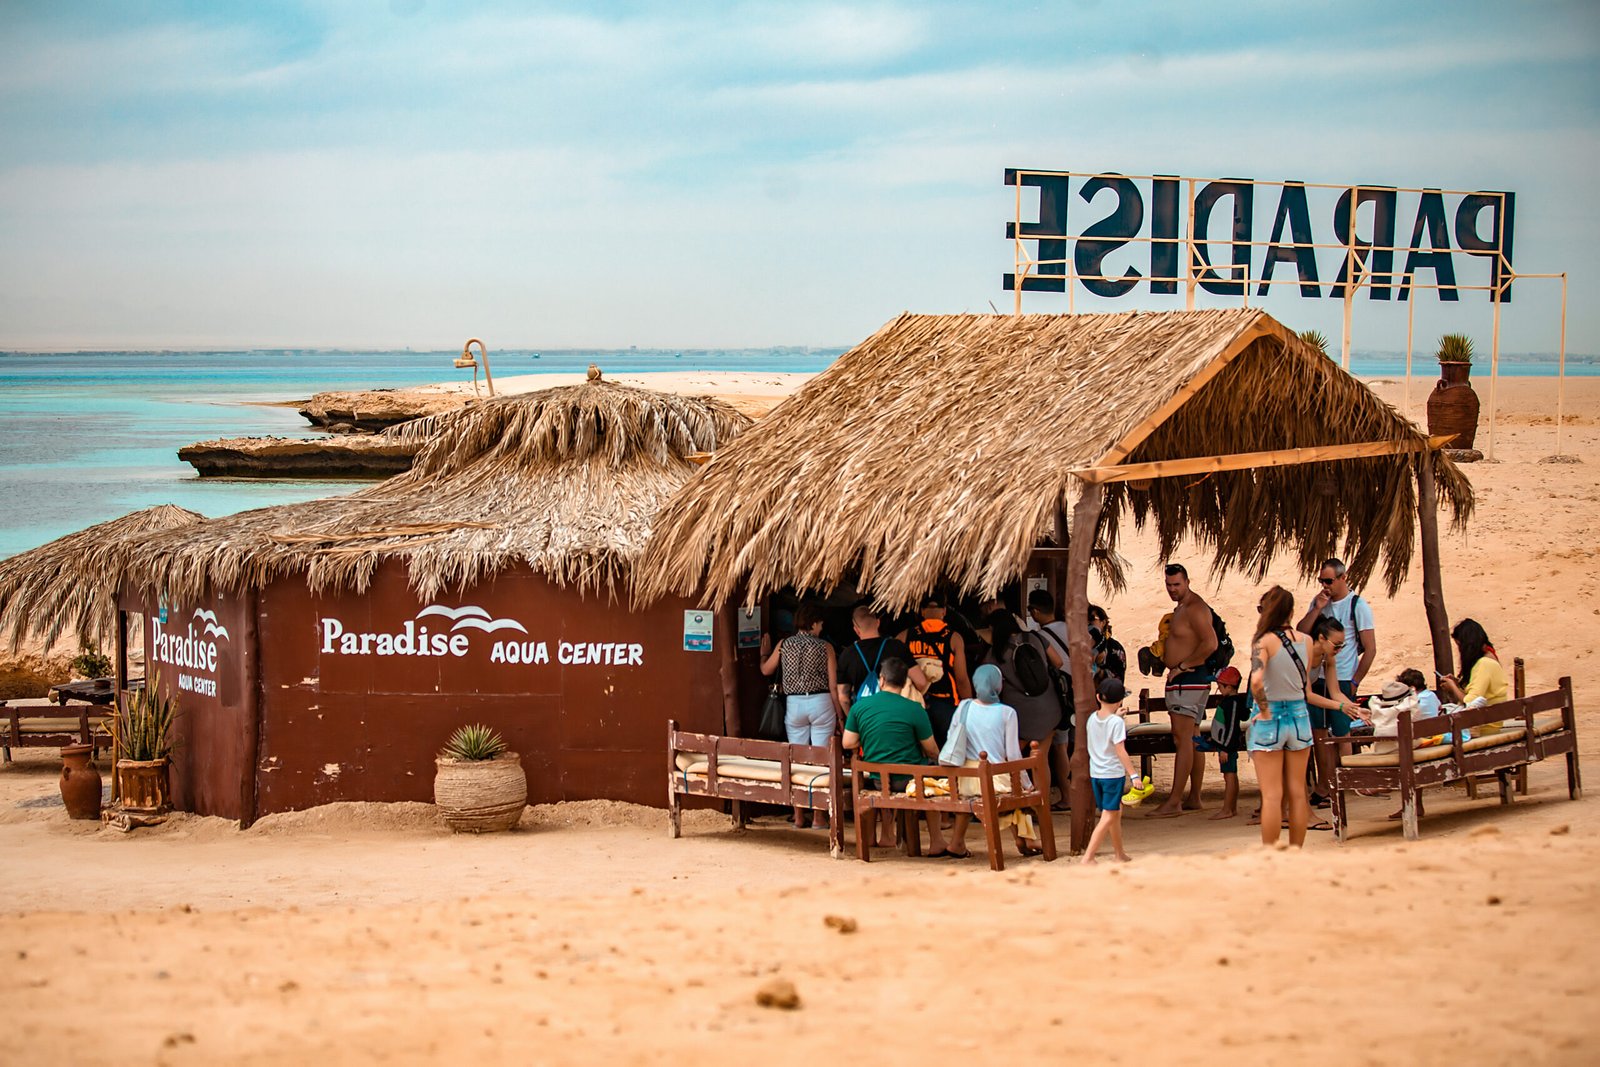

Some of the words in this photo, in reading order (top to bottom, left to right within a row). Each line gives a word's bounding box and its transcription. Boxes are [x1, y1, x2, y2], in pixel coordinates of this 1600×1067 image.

[152, 617, 217, 672] Paradise
[321, 617, 469, 657] Paradise
[923, 642, 945, 655] PAN
[490, 640, 550, 665] AQUA
[557, 642, 643, 667] CENTER
[179, 673, 193, 691] AQUA
[194, 677, 216, 697] CENTER
